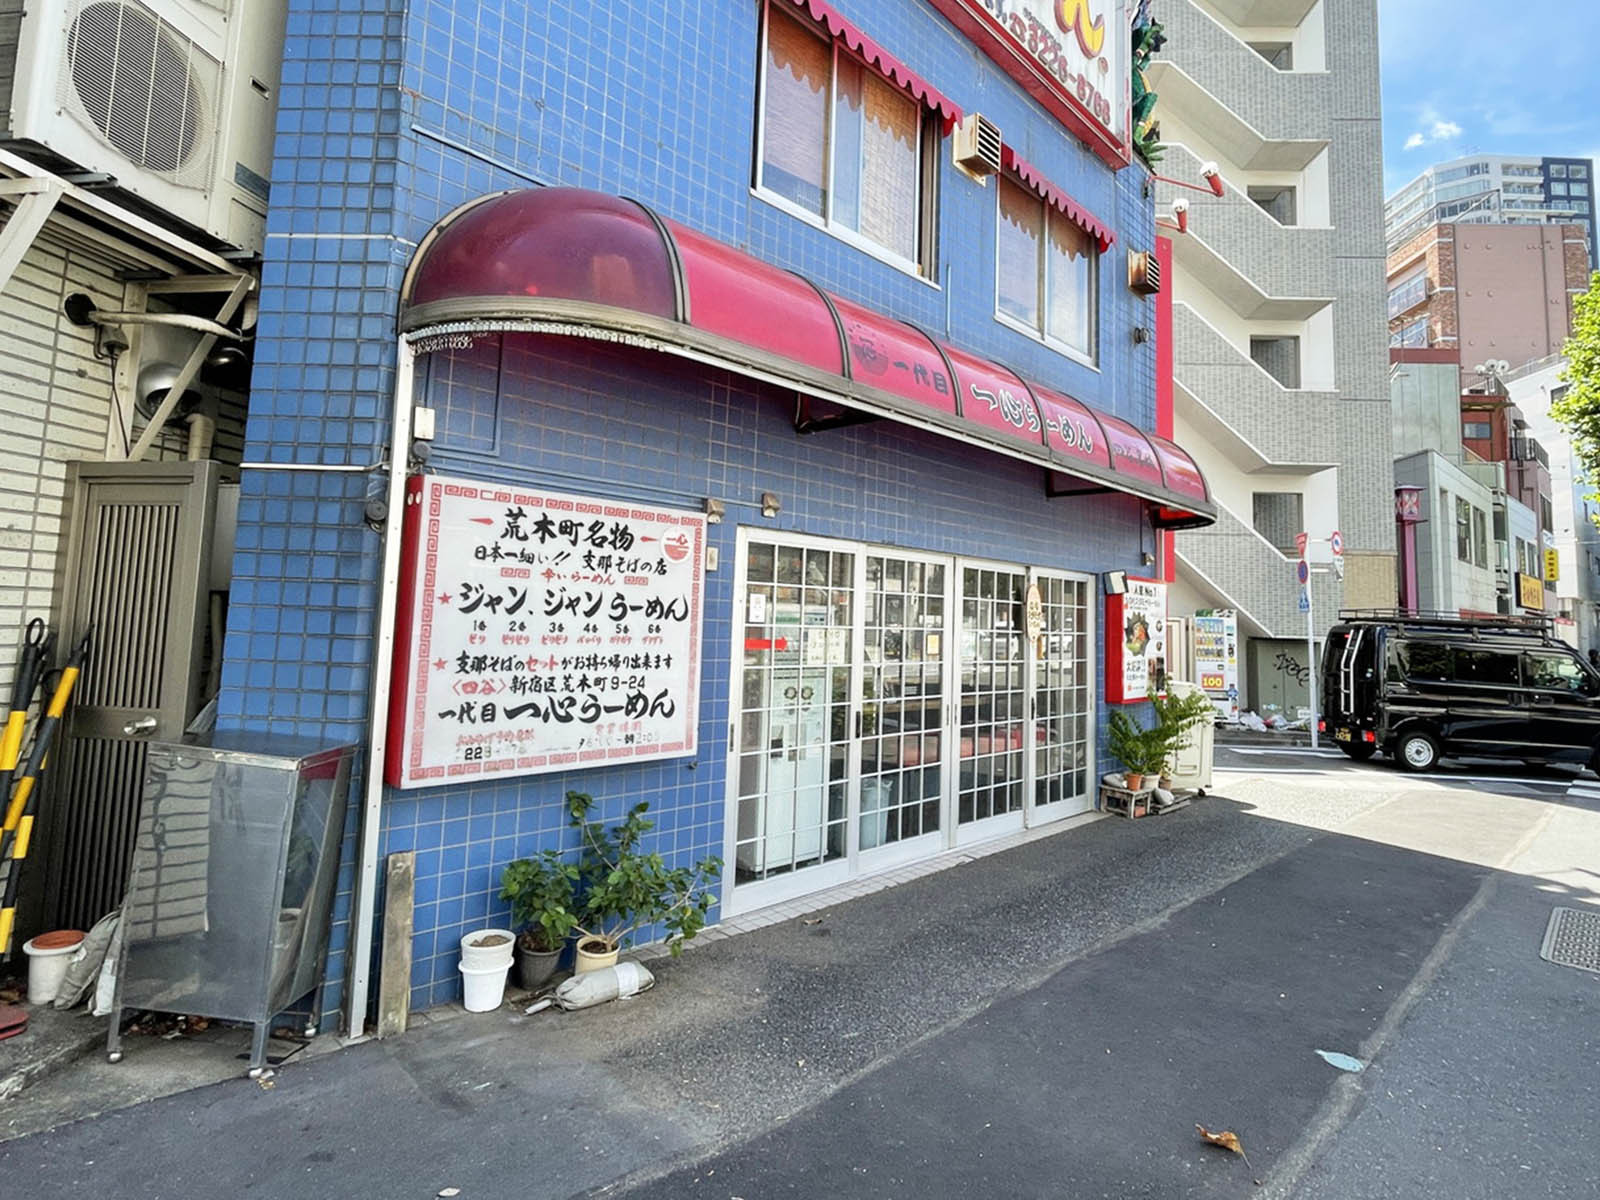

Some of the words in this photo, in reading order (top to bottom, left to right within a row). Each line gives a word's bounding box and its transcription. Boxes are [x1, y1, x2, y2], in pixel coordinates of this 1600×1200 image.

[892, 360, 950, 395] 一代目
[500, 506, 635, 551] 荒木町名物
[582, 550, 668, 576] 支那そばの店
[1202, 677, 1223, 687] 100
[438, 701, 497, 724] 一代目
[503, 688, 675, 724] 一心らーめん
